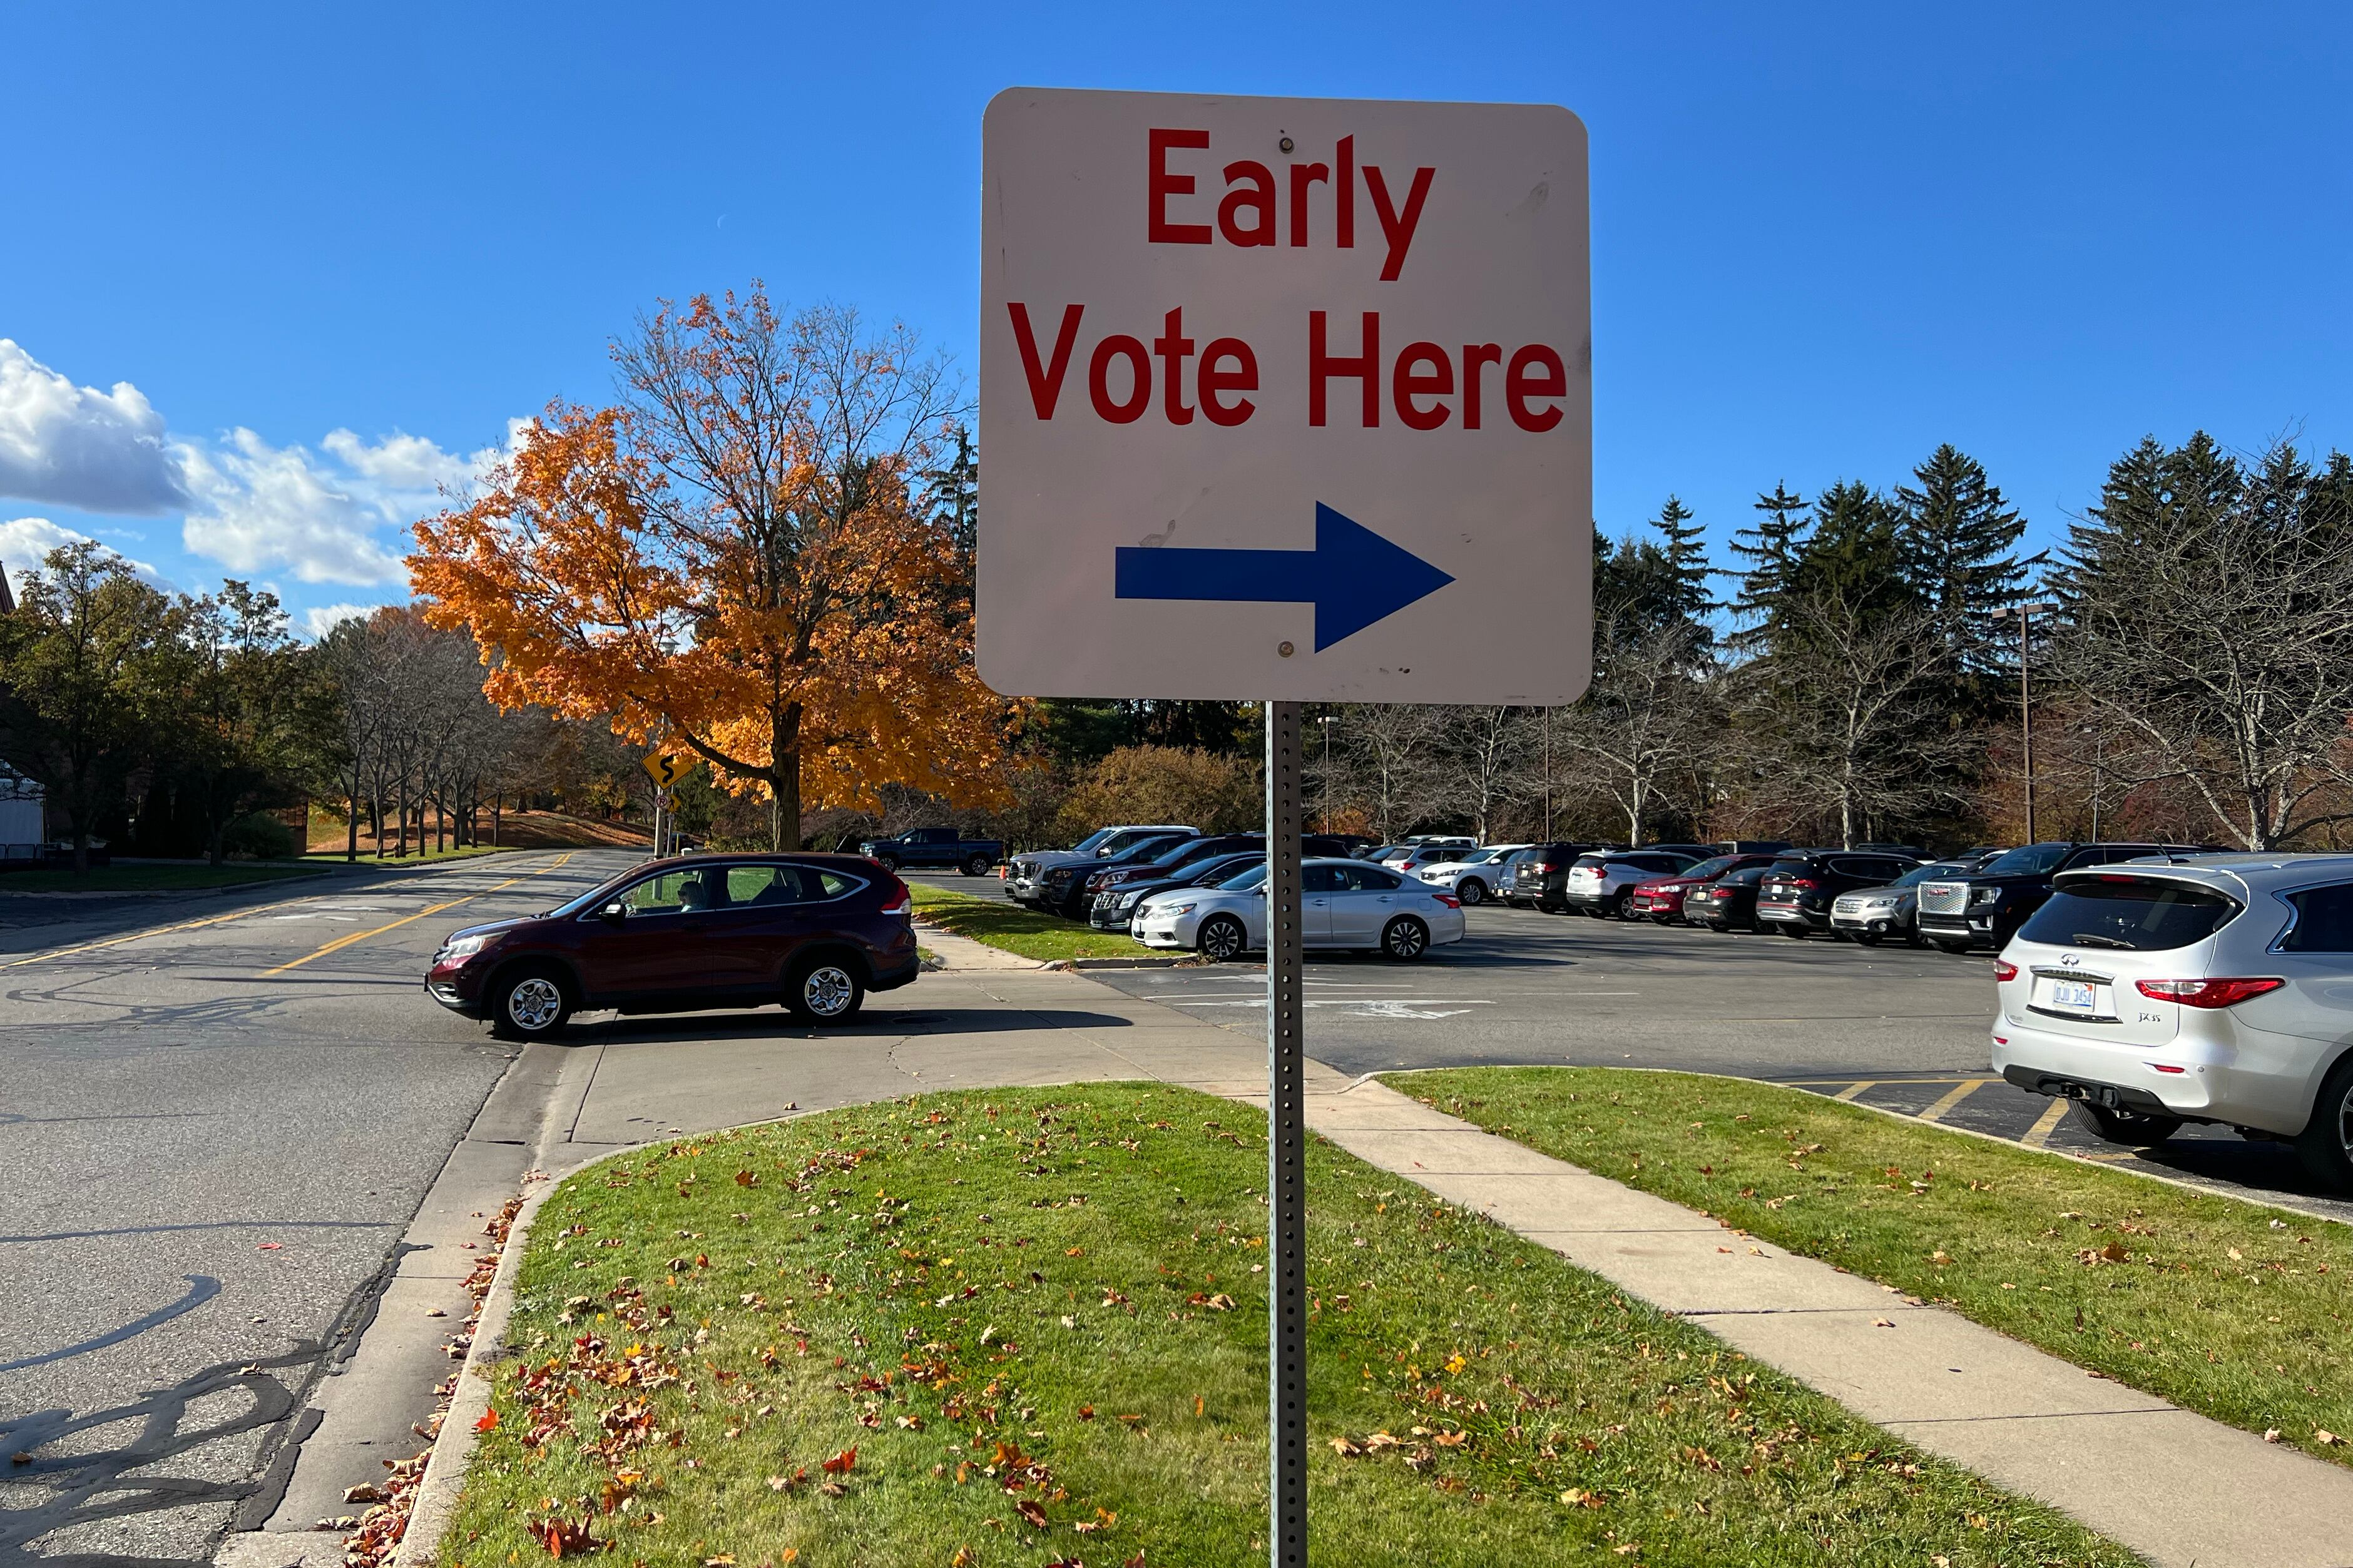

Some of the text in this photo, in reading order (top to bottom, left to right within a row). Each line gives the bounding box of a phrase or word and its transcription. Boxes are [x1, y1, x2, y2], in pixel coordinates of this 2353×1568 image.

[1149, 129, 1435, 282] Early
[1007, 302, 1566, 433] Vote Here
